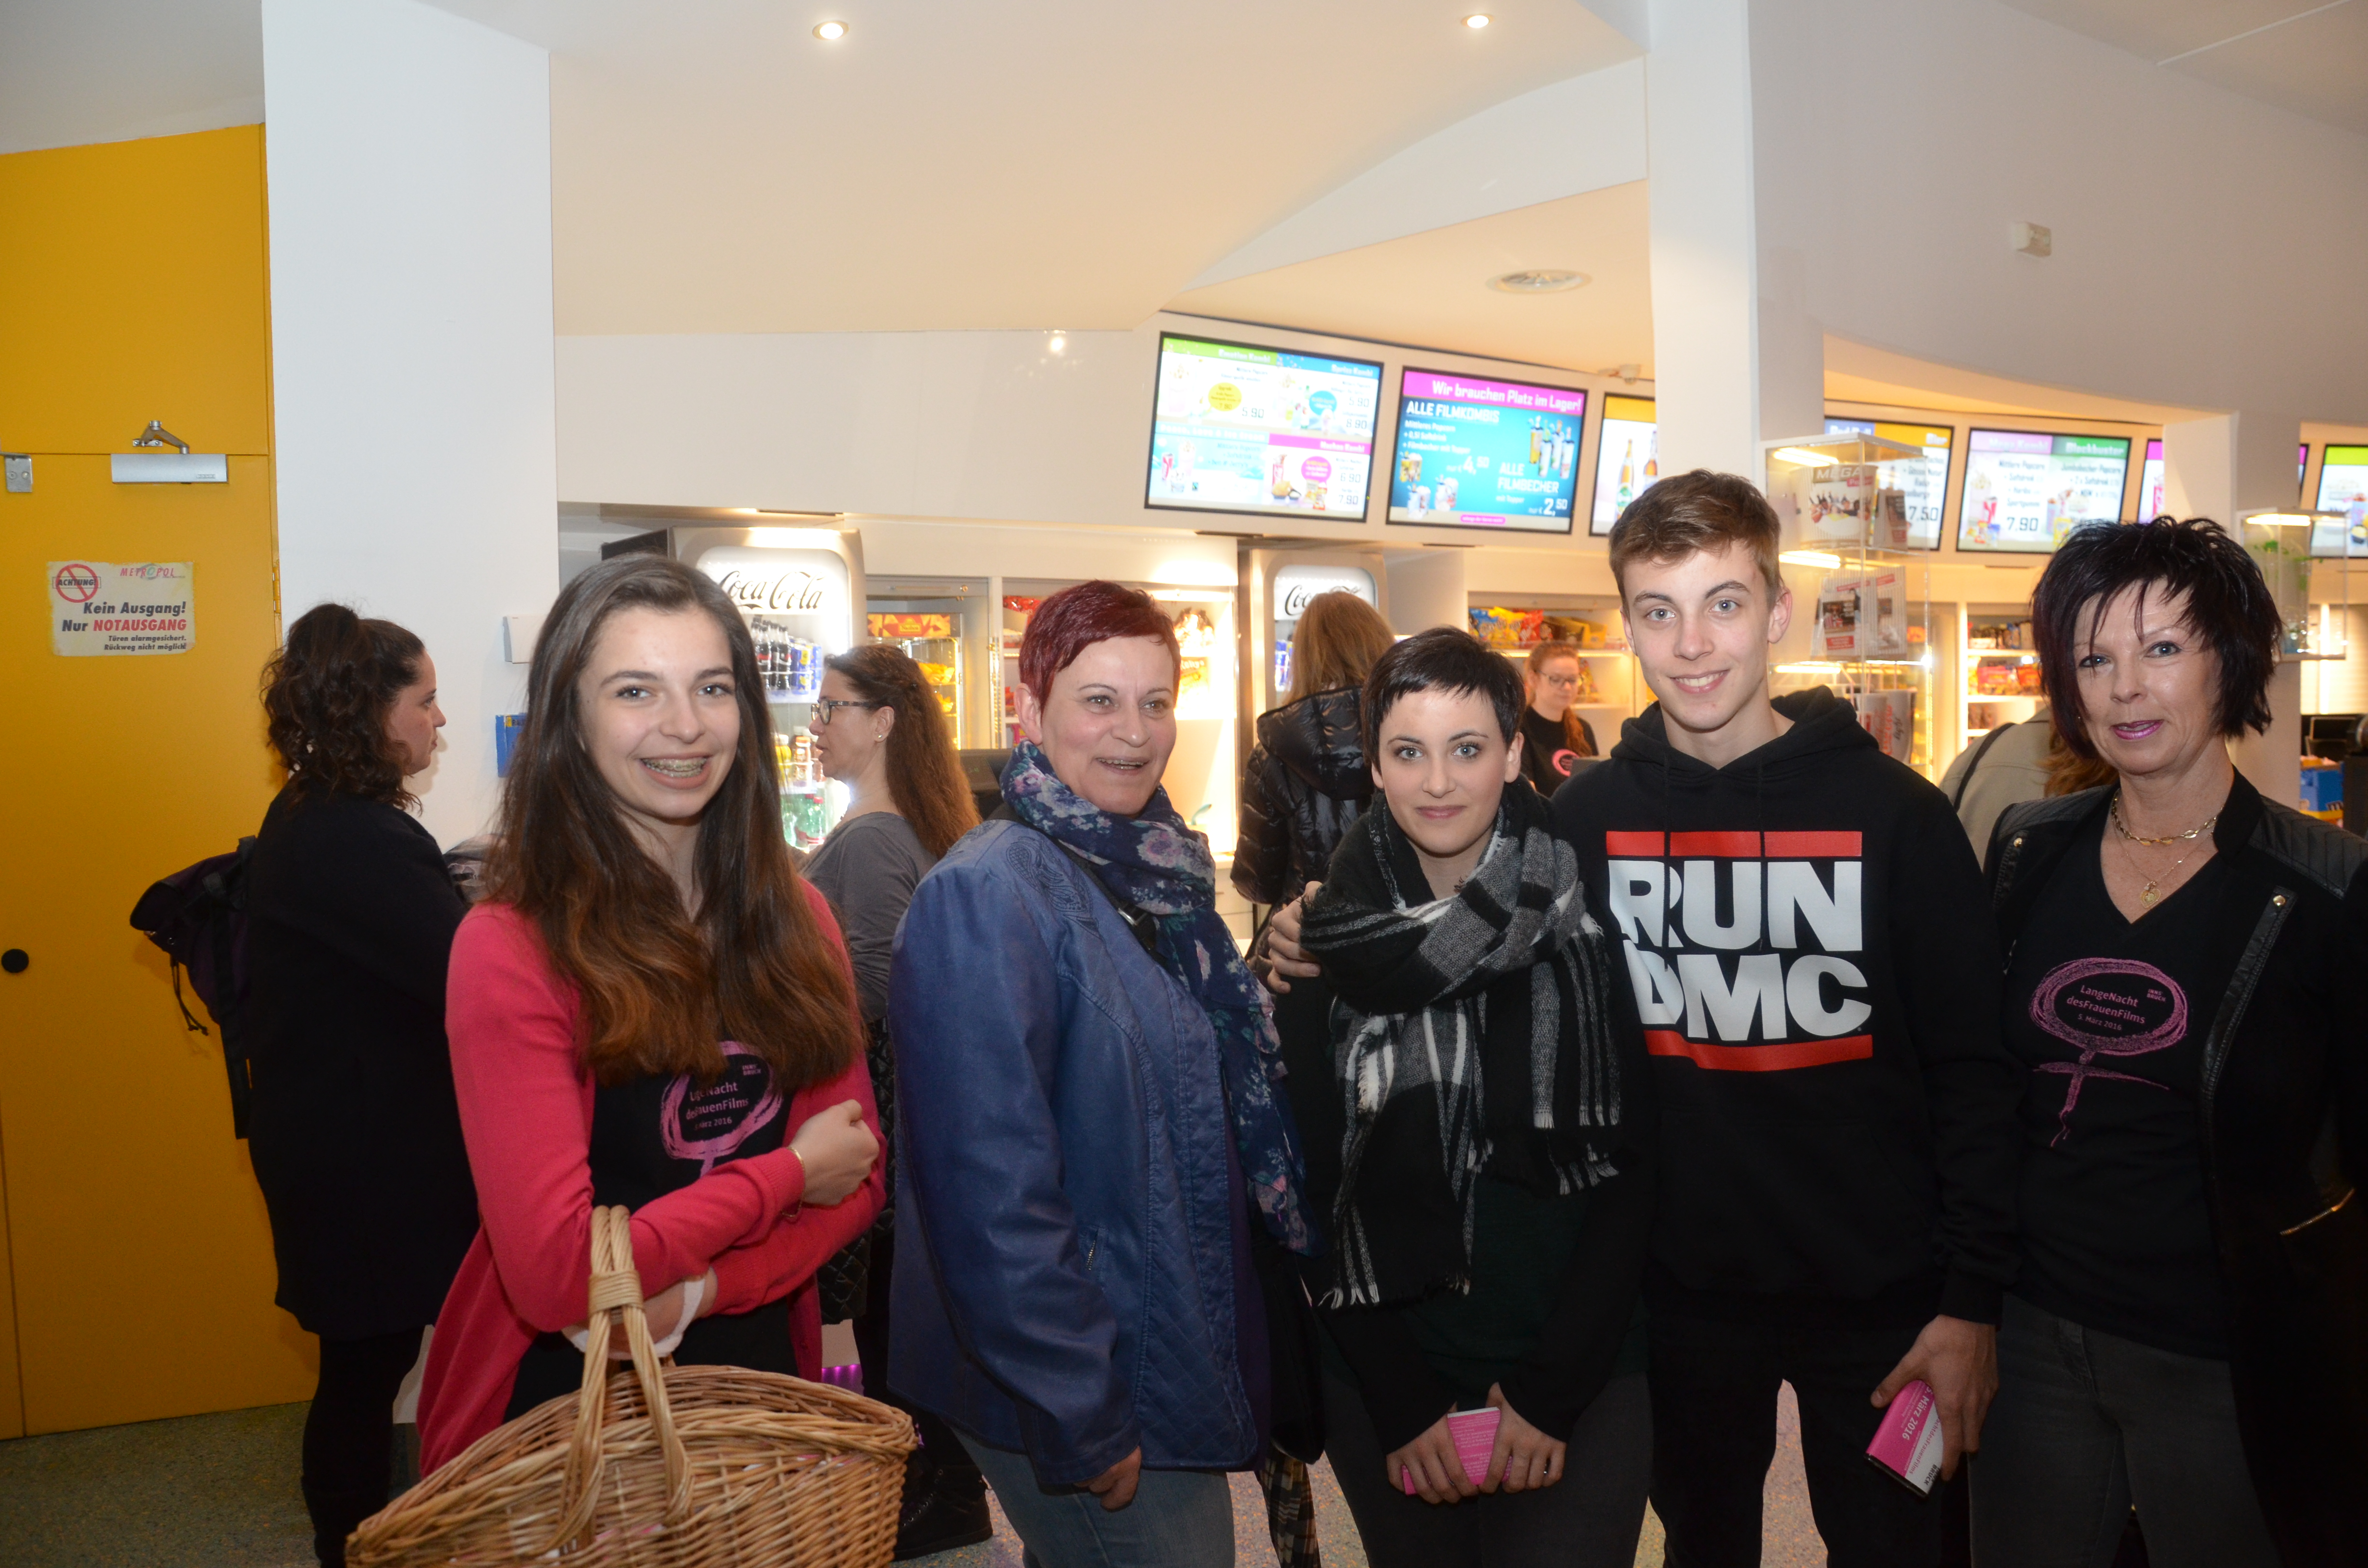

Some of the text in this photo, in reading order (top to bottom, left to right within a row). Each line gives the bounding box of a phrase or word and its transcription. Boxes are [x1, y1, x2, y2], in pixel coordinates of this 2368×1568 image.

[1432, 380, 1581, 413] Wir brauchen Platz im Lager!
[1406, 401, 1500, 423] ALLE FILMKOMBIS
[1499, 462, 1525, 476] ALLE
[1498, 477, 1559, 493] FILMBECHER
[2006, 516, 2039, 532] 7.90
[120, 566, 174, 577] METROPOL
[83, 601, 186, 617] Kein Ausgang!
[62, 619, 187, 632] Nur NOTAUSGANG
[131, 635, 187, 643] alarmgesichert.
[104, 644, 136, 652] Rückweg
[157, 643, 187, 652] möglich!
[1607, 859, 1862, 951] RUN
[1622, 939, 1872, 1041] DMC
[2080, 984, 2139, 1008] LangeNacht
[2066, 996, 2146, 1025] desFrauenFilms
[2085, 1015, 2103, 1027] März
[2103, 1020, 2122, 1031] 2016
[714, 1116, 733, 1127] 2016
[1913, 1394, 1930, 1418] März
[1902, 1417, 1918, 1441] 2016
